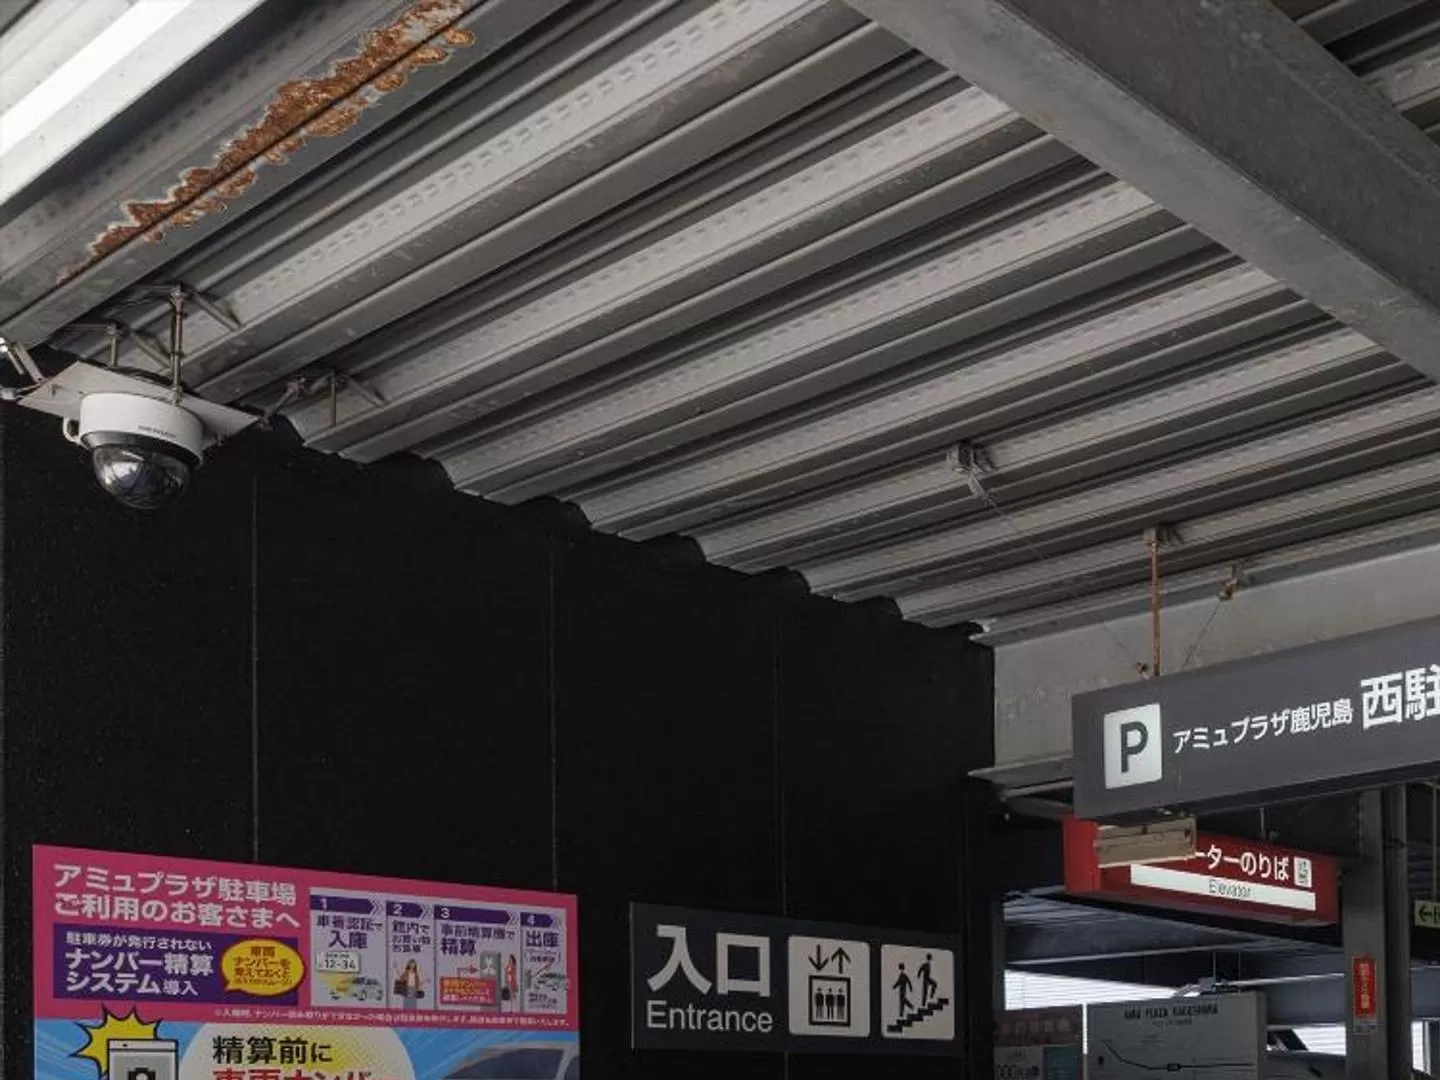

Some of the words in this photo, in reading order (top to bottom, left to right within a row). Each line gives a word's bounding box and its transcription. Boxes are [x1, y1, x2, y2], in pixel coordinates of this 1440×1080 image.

[1173, 699, 1353, 754] アミュプラザ鹿児島
[53, 863, 297, 907] アミュプラザ駐車場
[1209, 879, 1251, 898] Elevator
[54, 893, 300, 929] ご利用のお客さまへ
[65, 948, 214, 976] ナンバー精算
[647, 924, 771, 997] 入口
[66, 971, 199, 996] システム導入
[647, 1000, 773, 1034] Entrance
[212, 1036, 332, 1065] 精算前に
